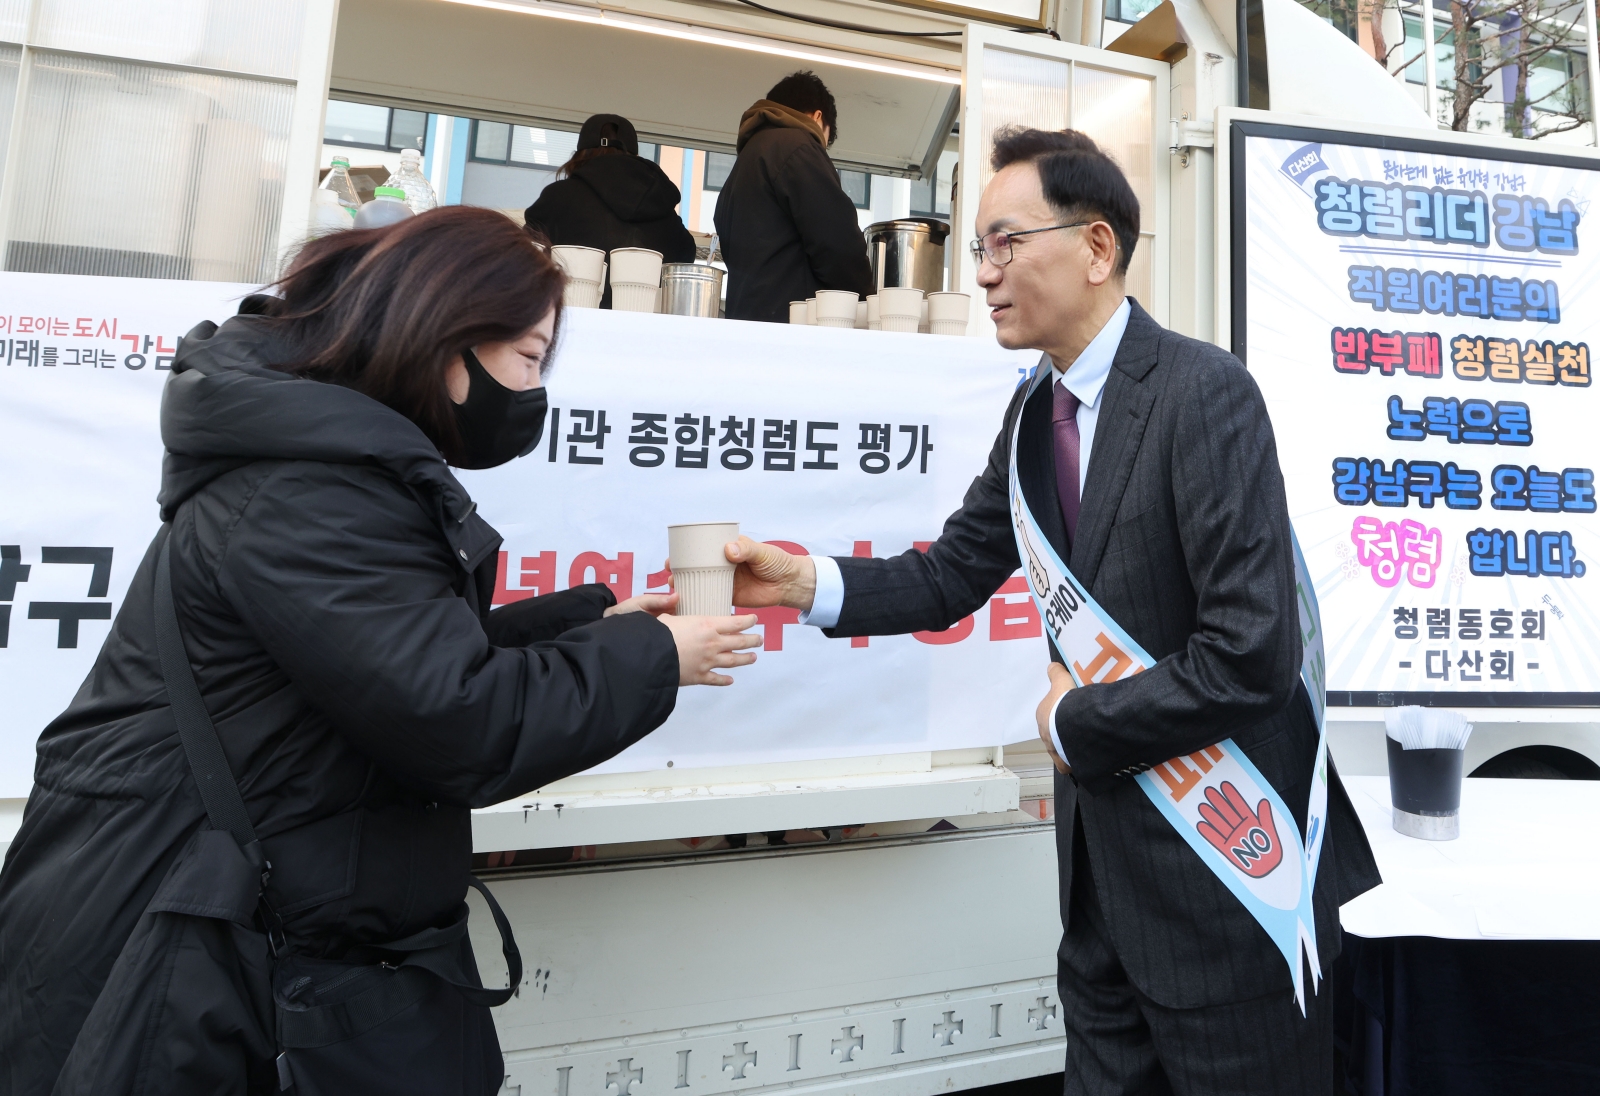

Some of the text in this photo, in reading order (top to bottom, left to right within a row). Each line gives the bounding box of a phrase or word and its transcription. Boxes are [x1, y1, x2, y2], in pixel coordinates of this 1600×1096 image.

[1288, 151, 1320, 176] 다산회
[1383, 160, 1526, 192] 못하는게 없는 육각형 강남구
[1315, 176, 1580, 256] 청렴리더 강남
[1348, 265, 1561, 324] 직원여러분의
[16, 316, 70, 337] 모이는
[73, 317, 117, 340] 도시
[63, 348, 117, 369] 그리는
[1331, 327, 1592, 388] 반부패 청렴실천
[628, 412, 839, 471] 종합청렴도
[857, 423, 933, 474] 평가
[1387, 395, 1534, 447] 노력으로
[1332, 457, 1597, 513] 강남구는 오늘도
[1351, 516, 1586, 589] 청렴 합니다.
[1046, 576, 1087, 640] 오케이
[1393, 606, 1546, 641] 청렴동호회
[1425, 649, 1515, 682] 다산회
[1231, 827, 1272, 869] NO
